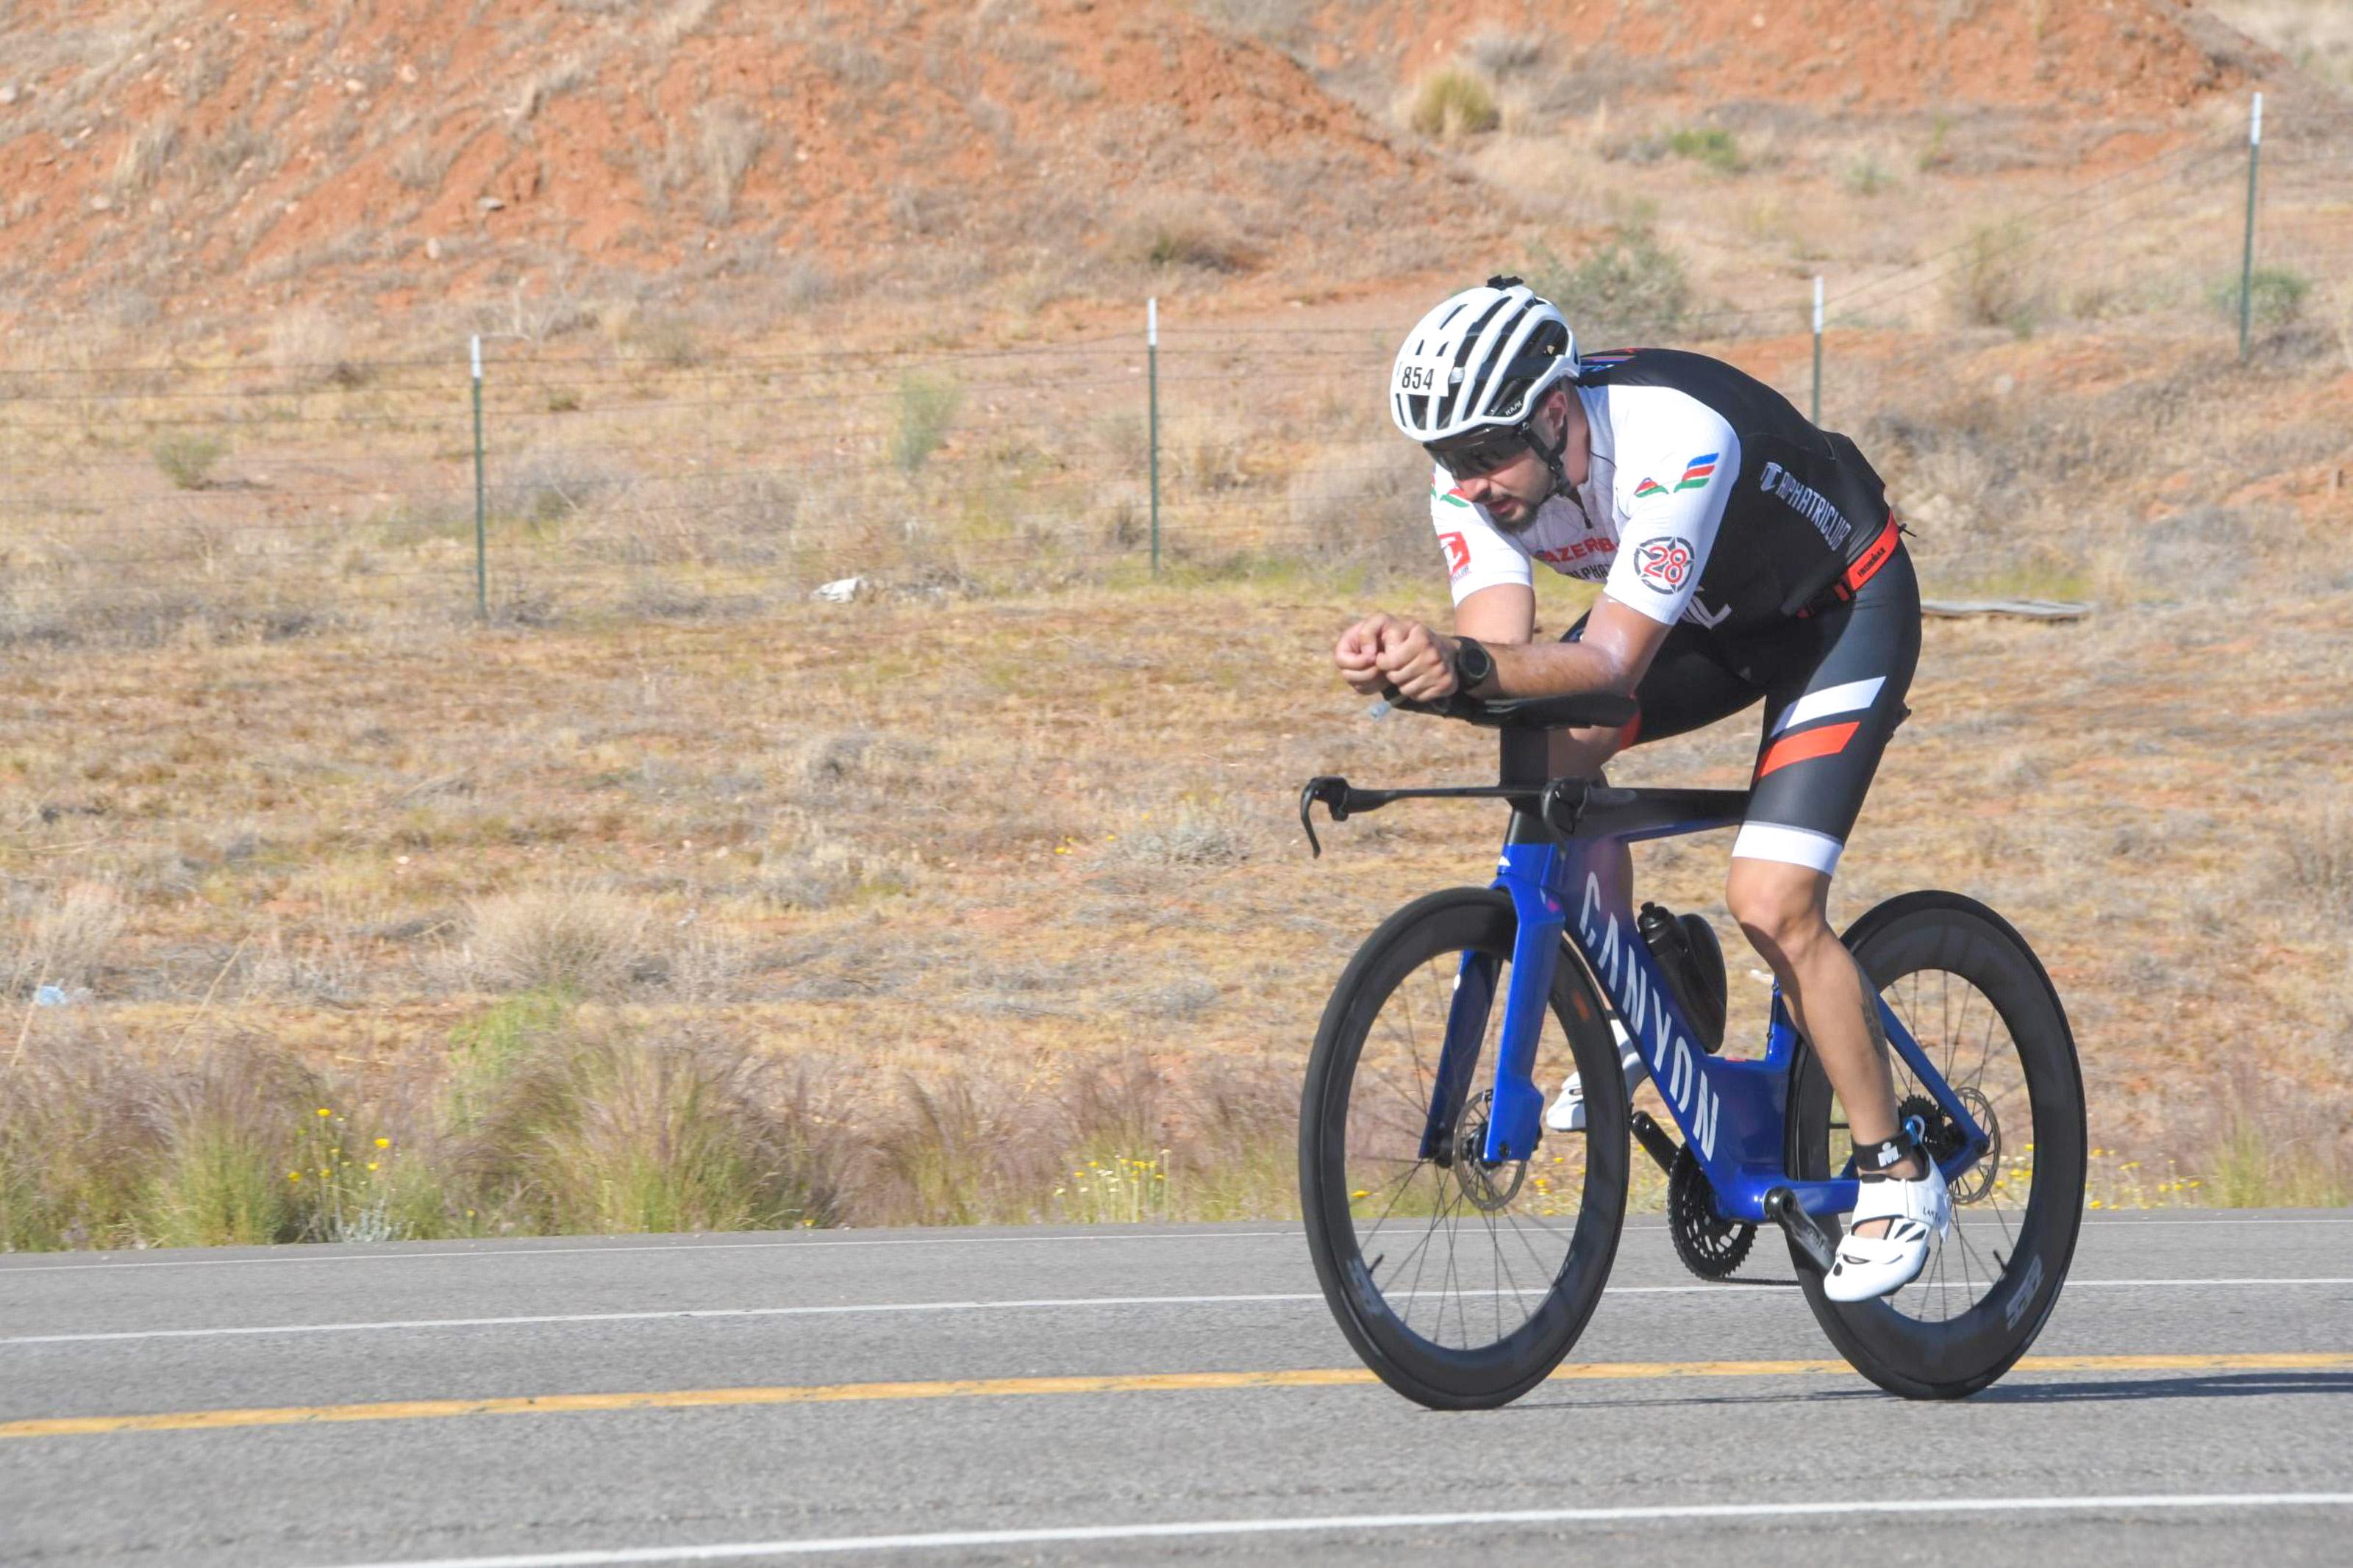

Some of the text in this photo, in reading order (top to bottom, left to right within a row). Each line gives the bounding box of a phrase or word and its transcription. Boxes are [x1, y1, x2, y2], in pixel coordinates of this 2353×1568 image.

[1401, 366, 1435, 390] 854
[1537, 537, 1618, 562] AZERB
[1643, 545, 1688, 584] 28
[1579, 872, 1719, 1162] CANYON
